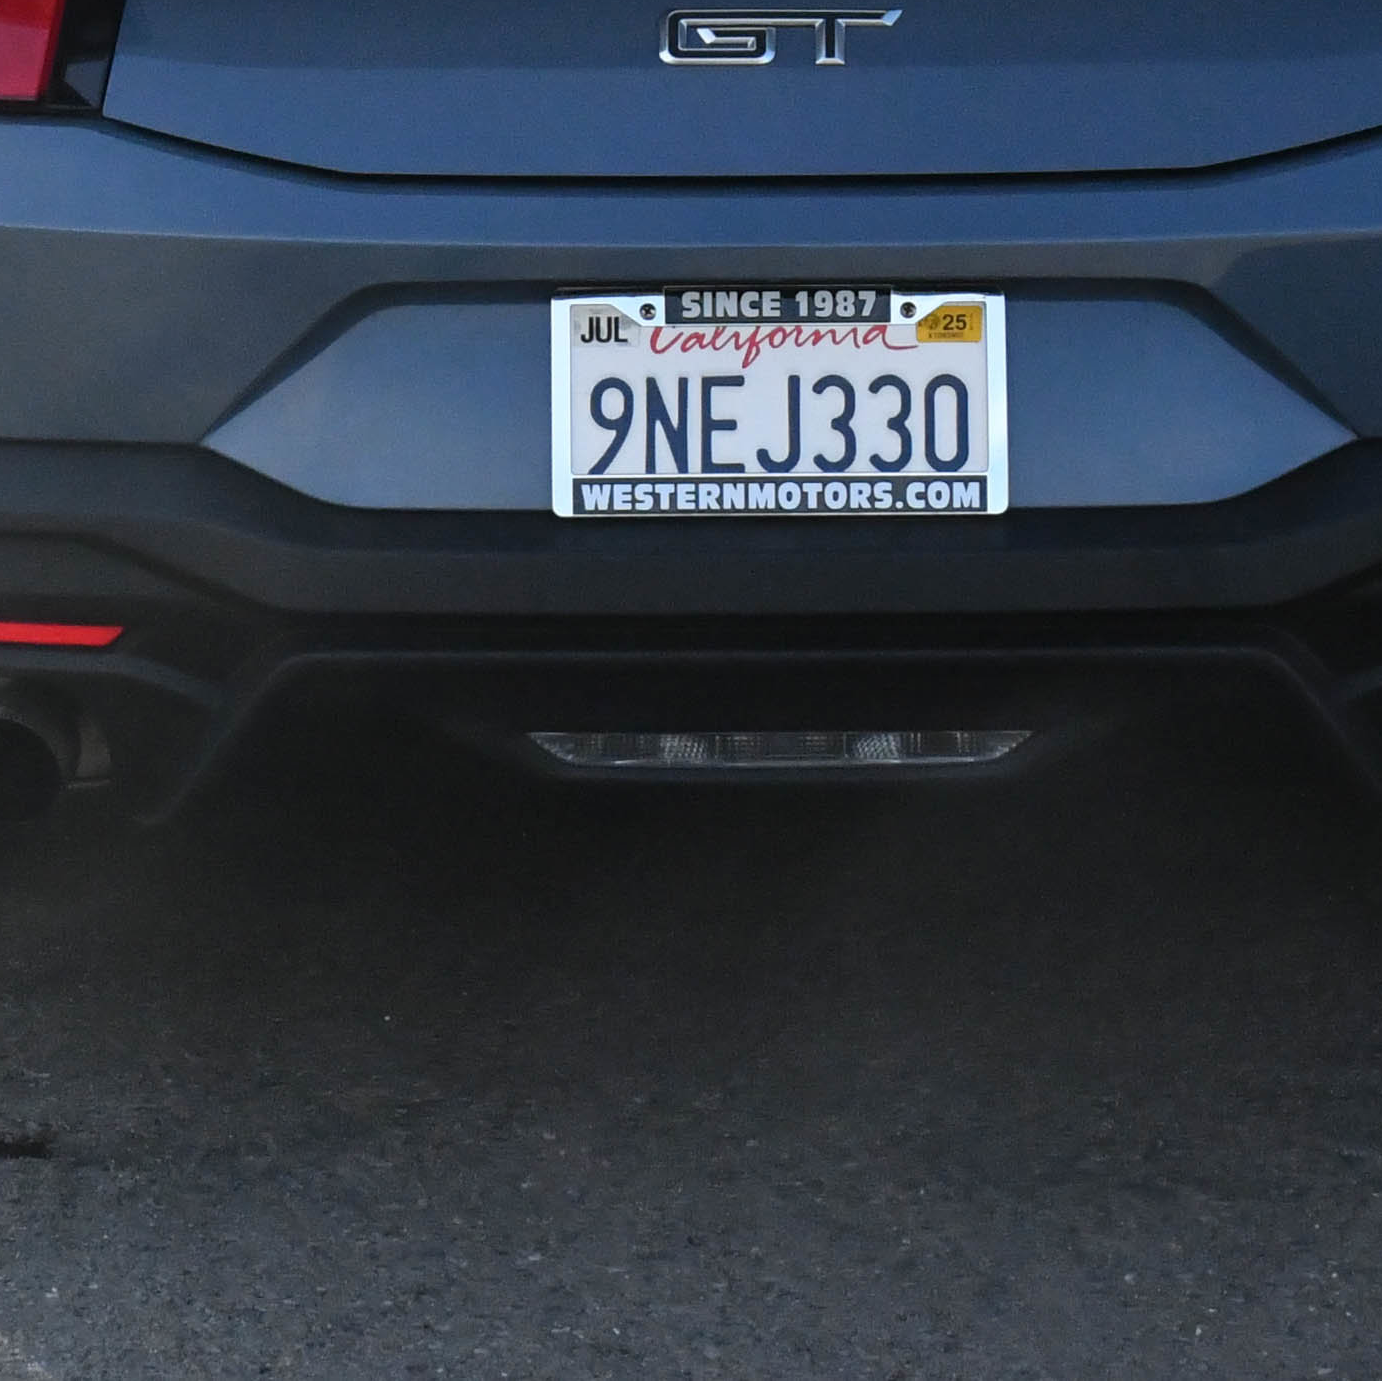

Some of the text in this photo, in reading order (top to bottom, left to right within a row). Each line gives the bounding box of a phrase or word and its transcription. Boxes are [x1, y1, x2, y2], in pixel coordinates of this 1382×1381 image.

[658, 8, 904, 66] GT
[681, 290, 877, 318] SINCE 1987
[580, 315, 629, 344] JUL
[942, 313, 967, 331] 25
[588, 373, 969, 474] 9NEJ330
[581, 481, 981, 512] WESTERNMOTORS.COM
